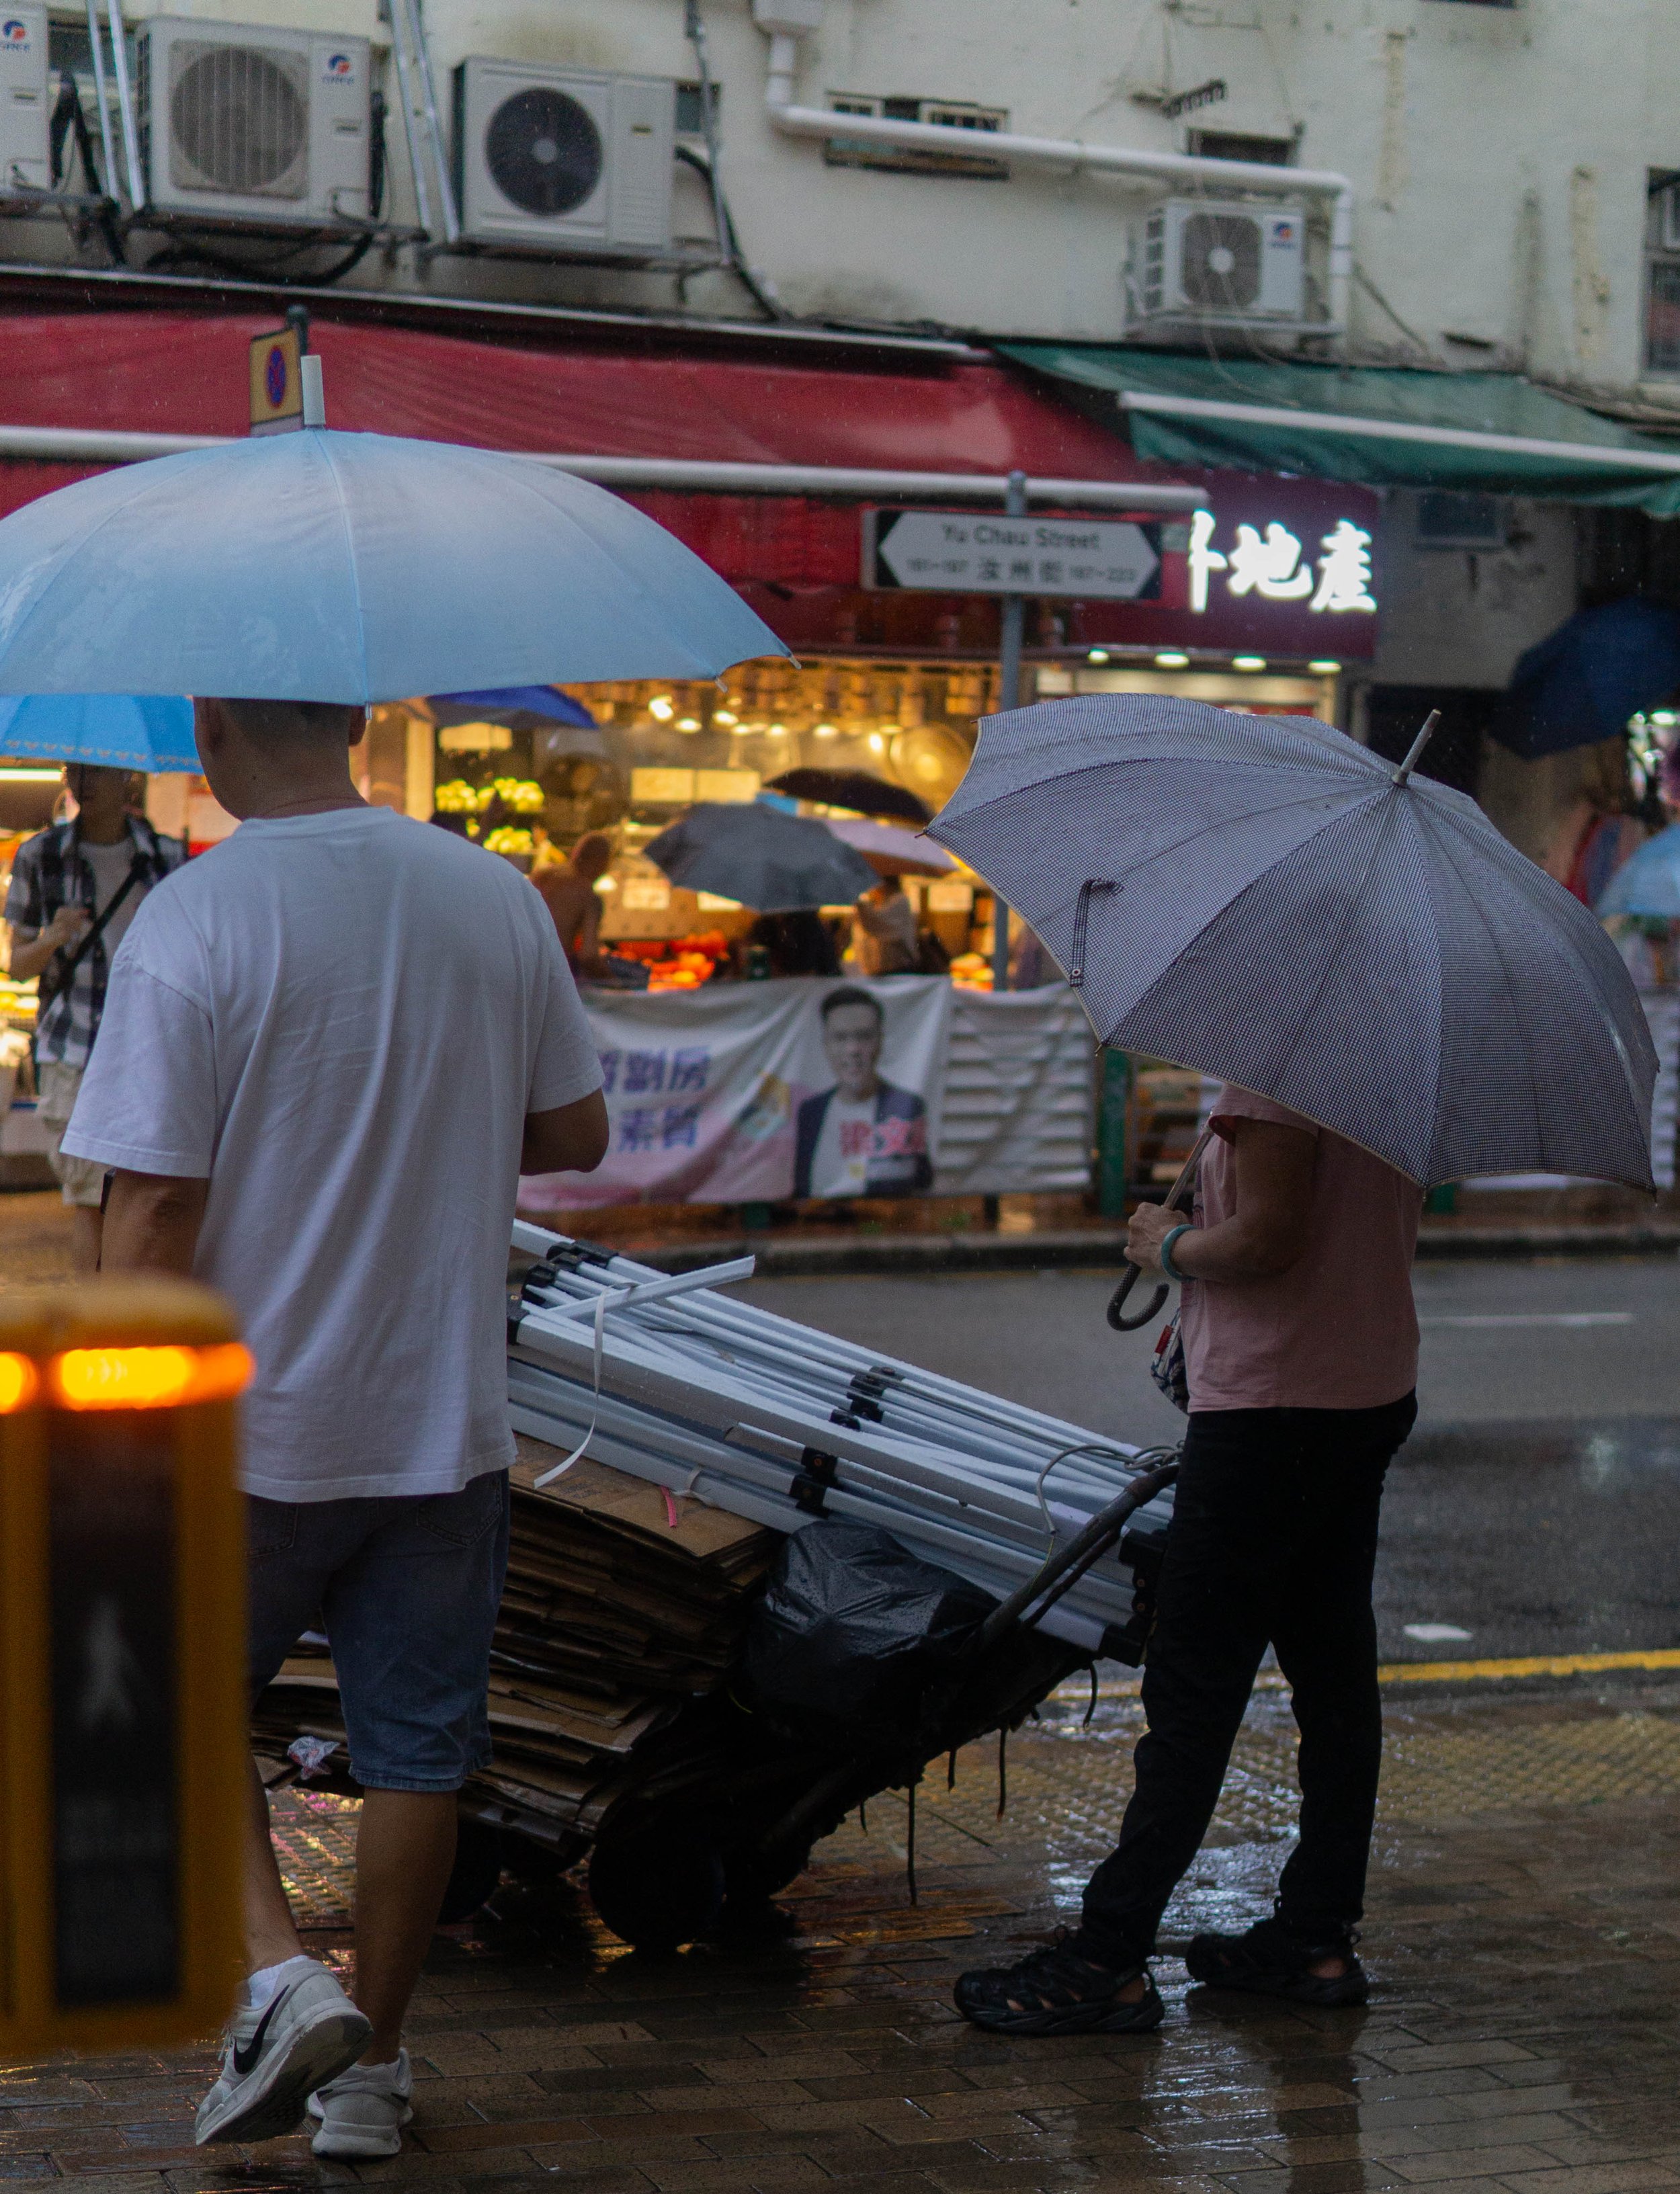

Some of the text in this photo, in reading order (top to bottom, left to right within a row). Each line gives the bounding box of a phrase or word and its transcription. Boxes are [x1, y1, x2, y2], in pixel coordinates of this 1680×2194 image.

[942, 523, 1100, 549] Yu Chau Street
